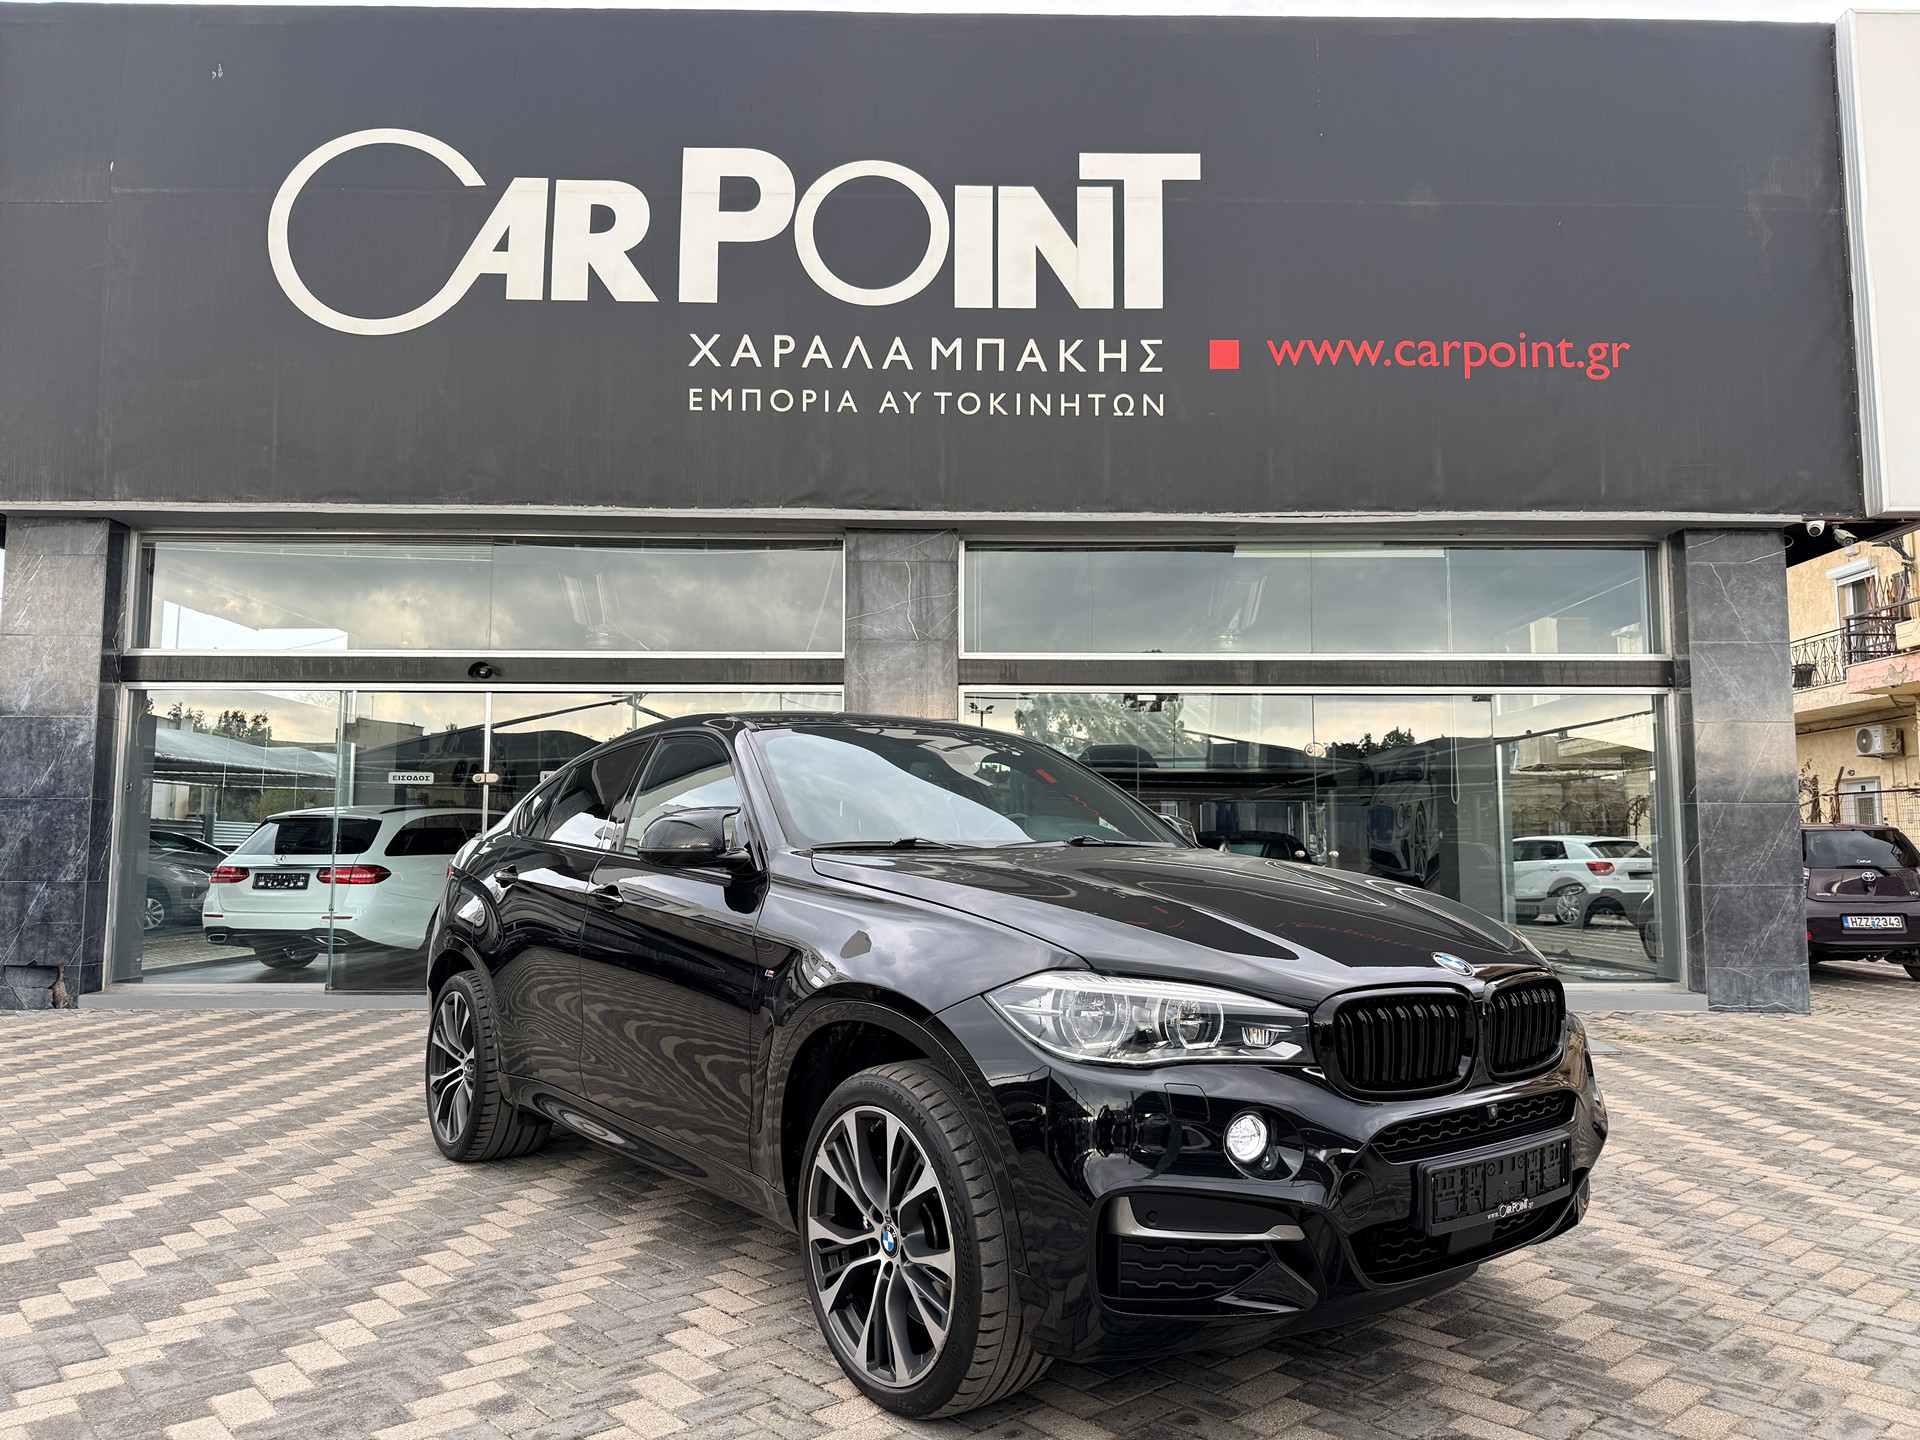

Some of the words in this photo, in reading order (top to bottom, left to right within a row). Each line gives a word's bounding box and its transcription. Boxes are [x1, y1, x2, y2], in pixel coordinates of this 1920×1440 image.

[268, 128, 659, 335] CAR
[679, 148, 1201, 309] POINT
[689, 334, 1163, 373] ΧΑΡΑΛΑΜΠΑΚΗΣ
[1267, 333, 1631, 381] www.carpoint.gr
[689, 387, 858, 413] ΕΜΠΟΡΙΑ
[392, 774, 431, 782] ΕΙΣΟΔΟΣ
